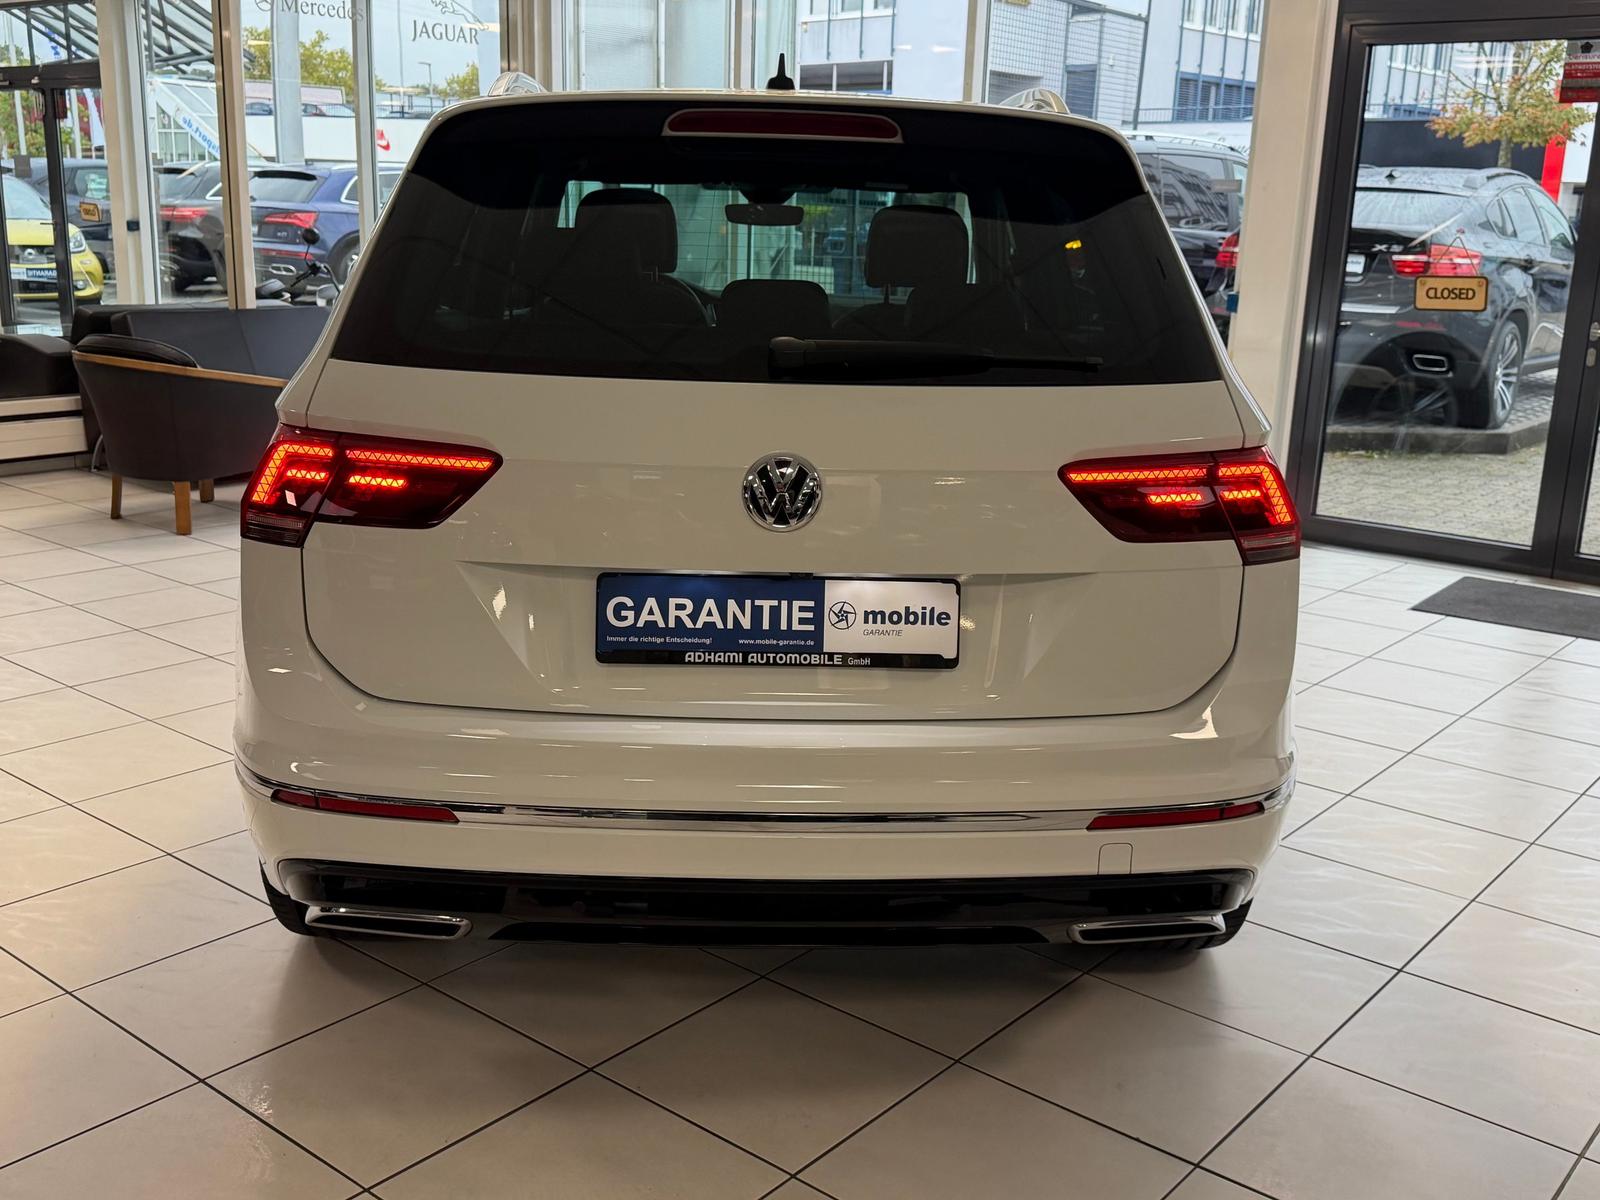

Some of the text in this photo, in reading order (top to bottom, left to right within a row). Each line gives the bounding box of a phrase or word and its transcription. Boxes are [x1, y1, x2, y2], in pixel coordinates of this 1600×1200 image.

[281, 0, 364, 22] Mercedes
[412, 19, 480, 45] JAGUAR
[1425, 287, 1476, 301] CLOSED
[606, 596, 815, 631] GARANTIE
[863, 606, 952, 627] mobile
[606, 635, 713, 645] Immer die richtige Entscheidung!
[862, 629, 904, 637] GARANTIE
[738, 638, 815, 646] www.mobile-garantie.de
[684, 652, 871, 666] ADHAMI AUTOMOBILE GmbH
